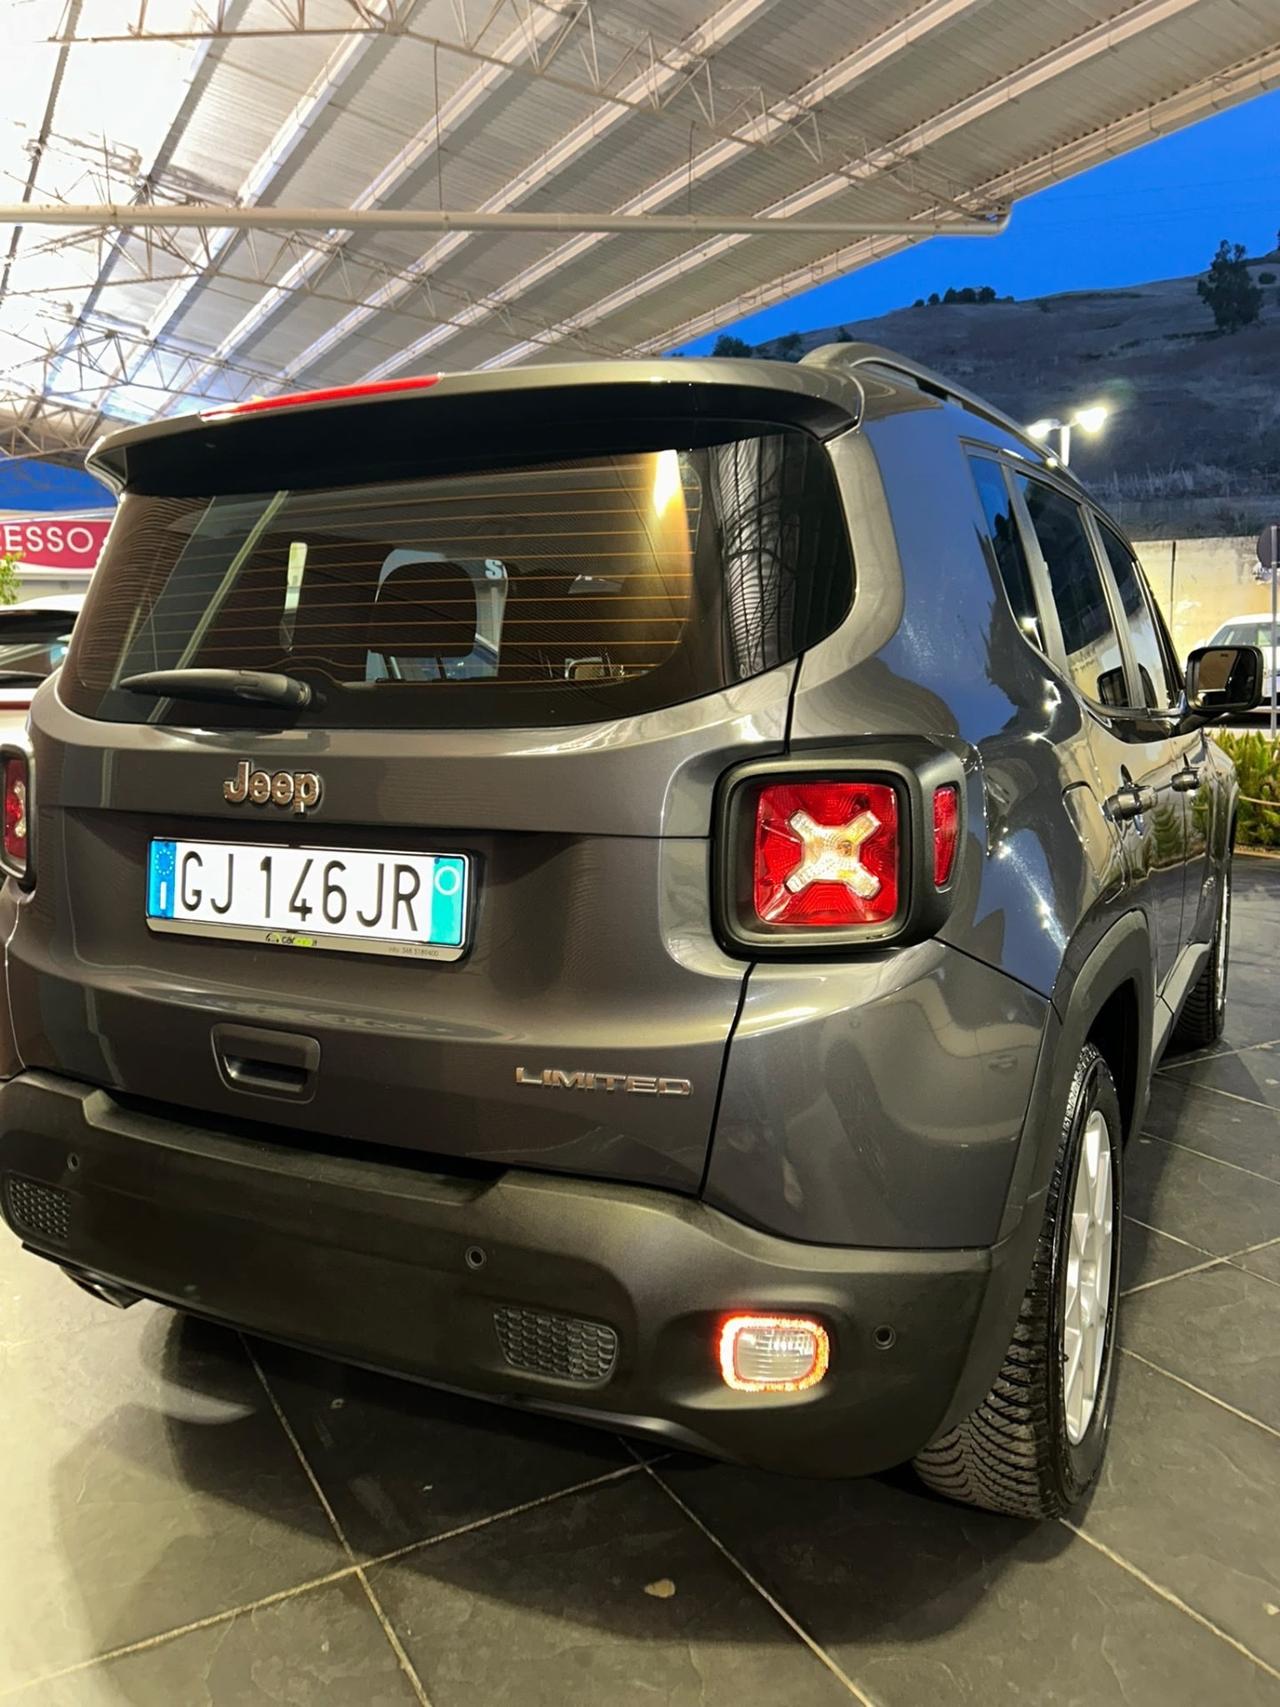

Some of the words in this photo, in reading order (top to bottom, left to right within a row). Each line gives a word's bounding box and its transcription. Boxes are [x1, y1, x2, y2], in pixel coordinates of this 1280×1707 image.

[0, 525, 94, 553] ESSO
[223, 760, 321, 815] Jeep
[180, 851, 234, 914] GJ
[515, 1066, 693, 1096] LIMITED
